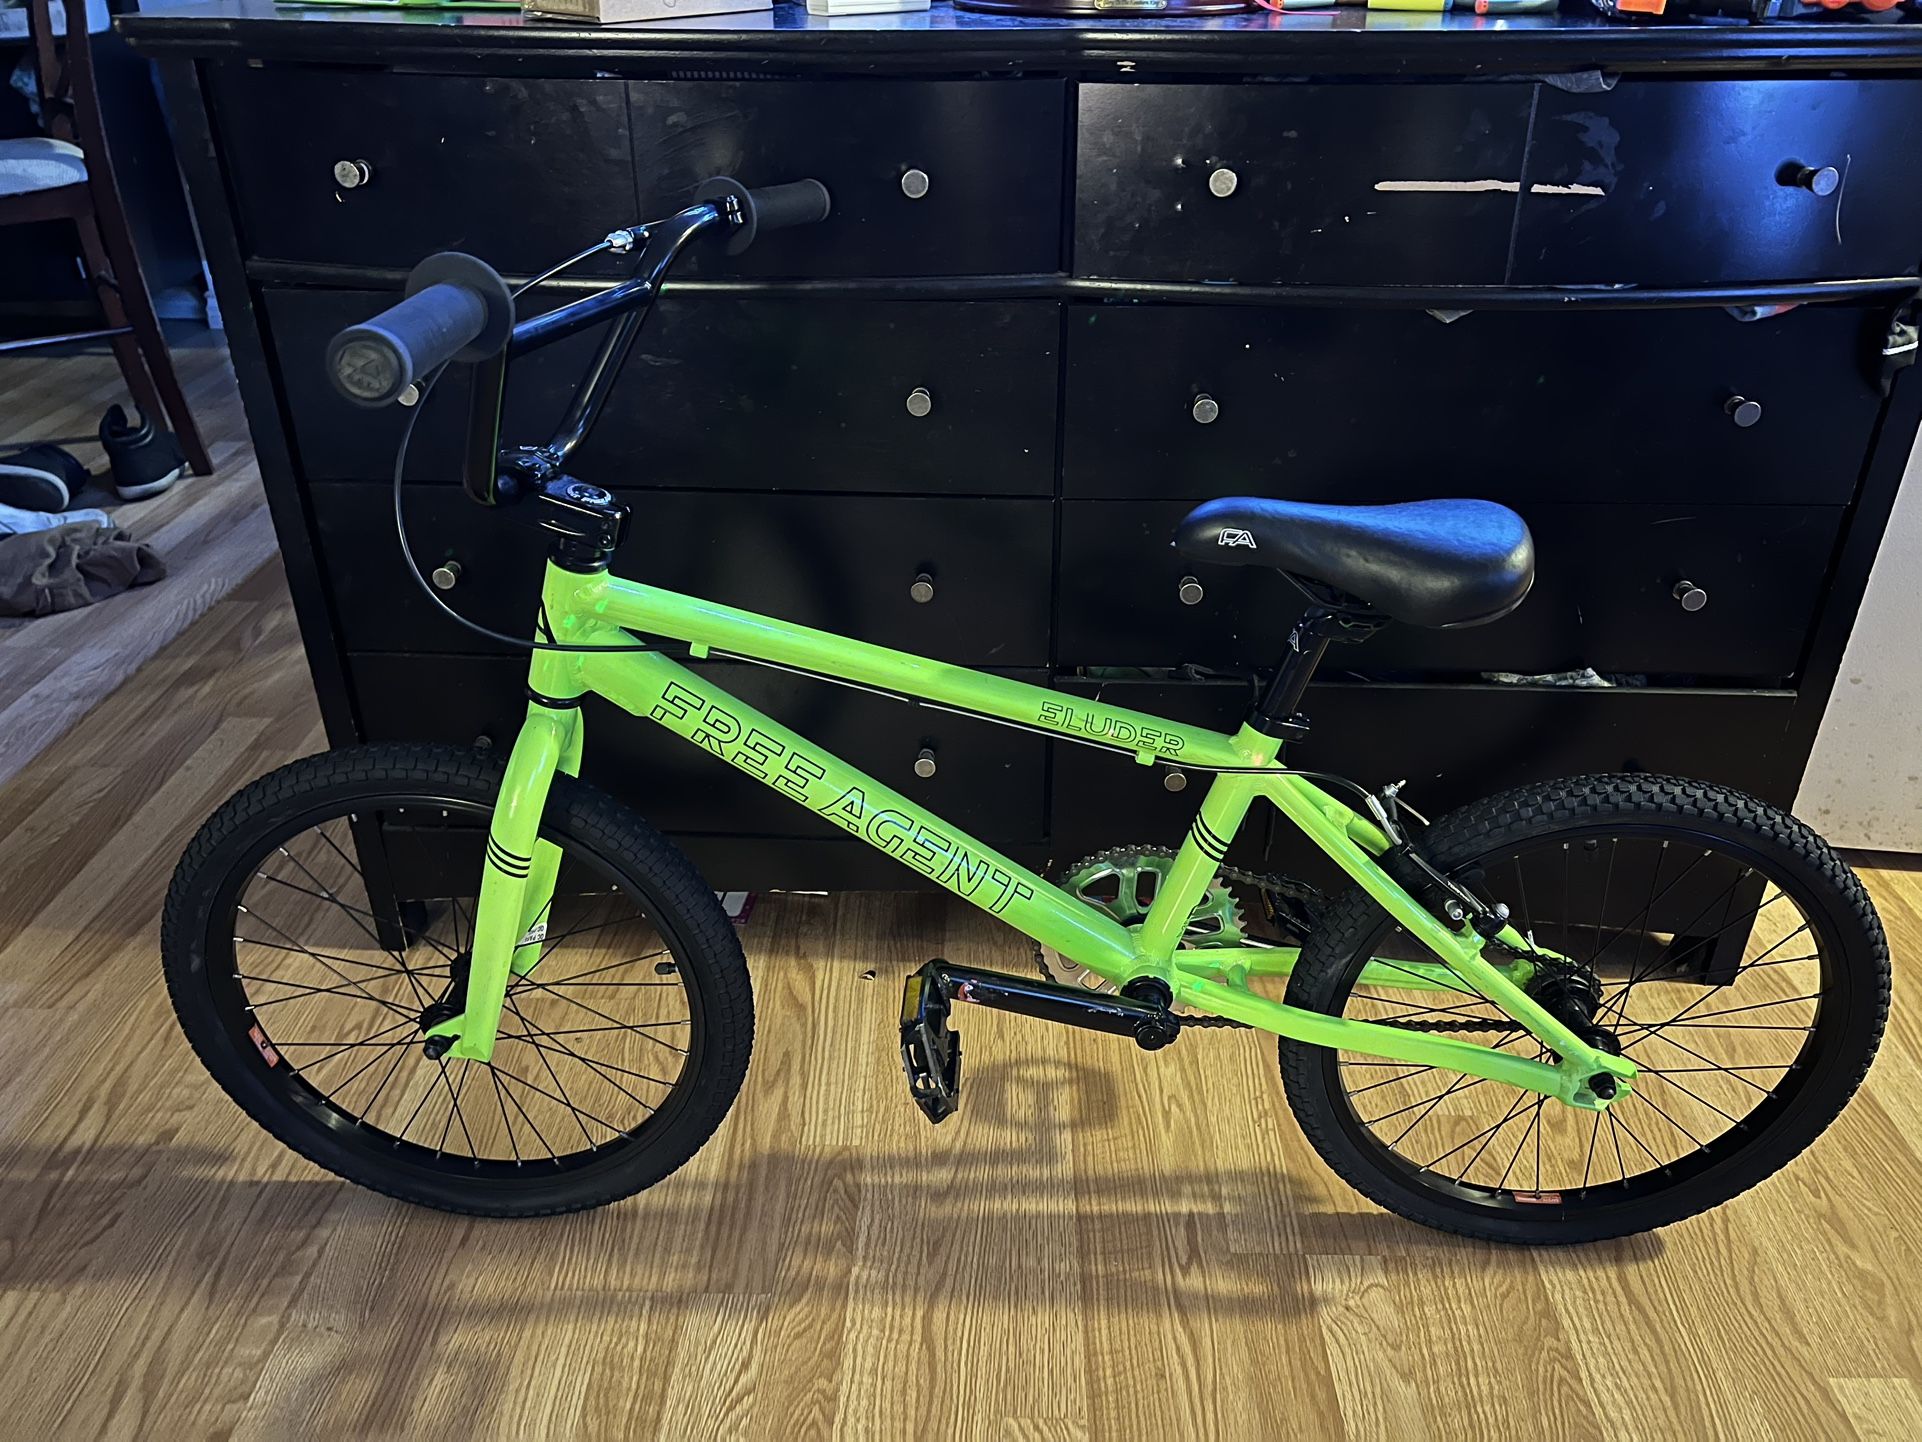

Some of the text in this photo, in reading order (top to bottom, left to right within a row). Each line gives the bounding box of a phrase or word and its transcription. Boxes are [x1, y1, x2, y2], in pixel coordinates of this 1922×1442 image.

[1218, 528, 1257, 548] FA
[1038, 701, 1185, 757] ELUDER
[649, 681, 1034, 915] FREE AGENT
